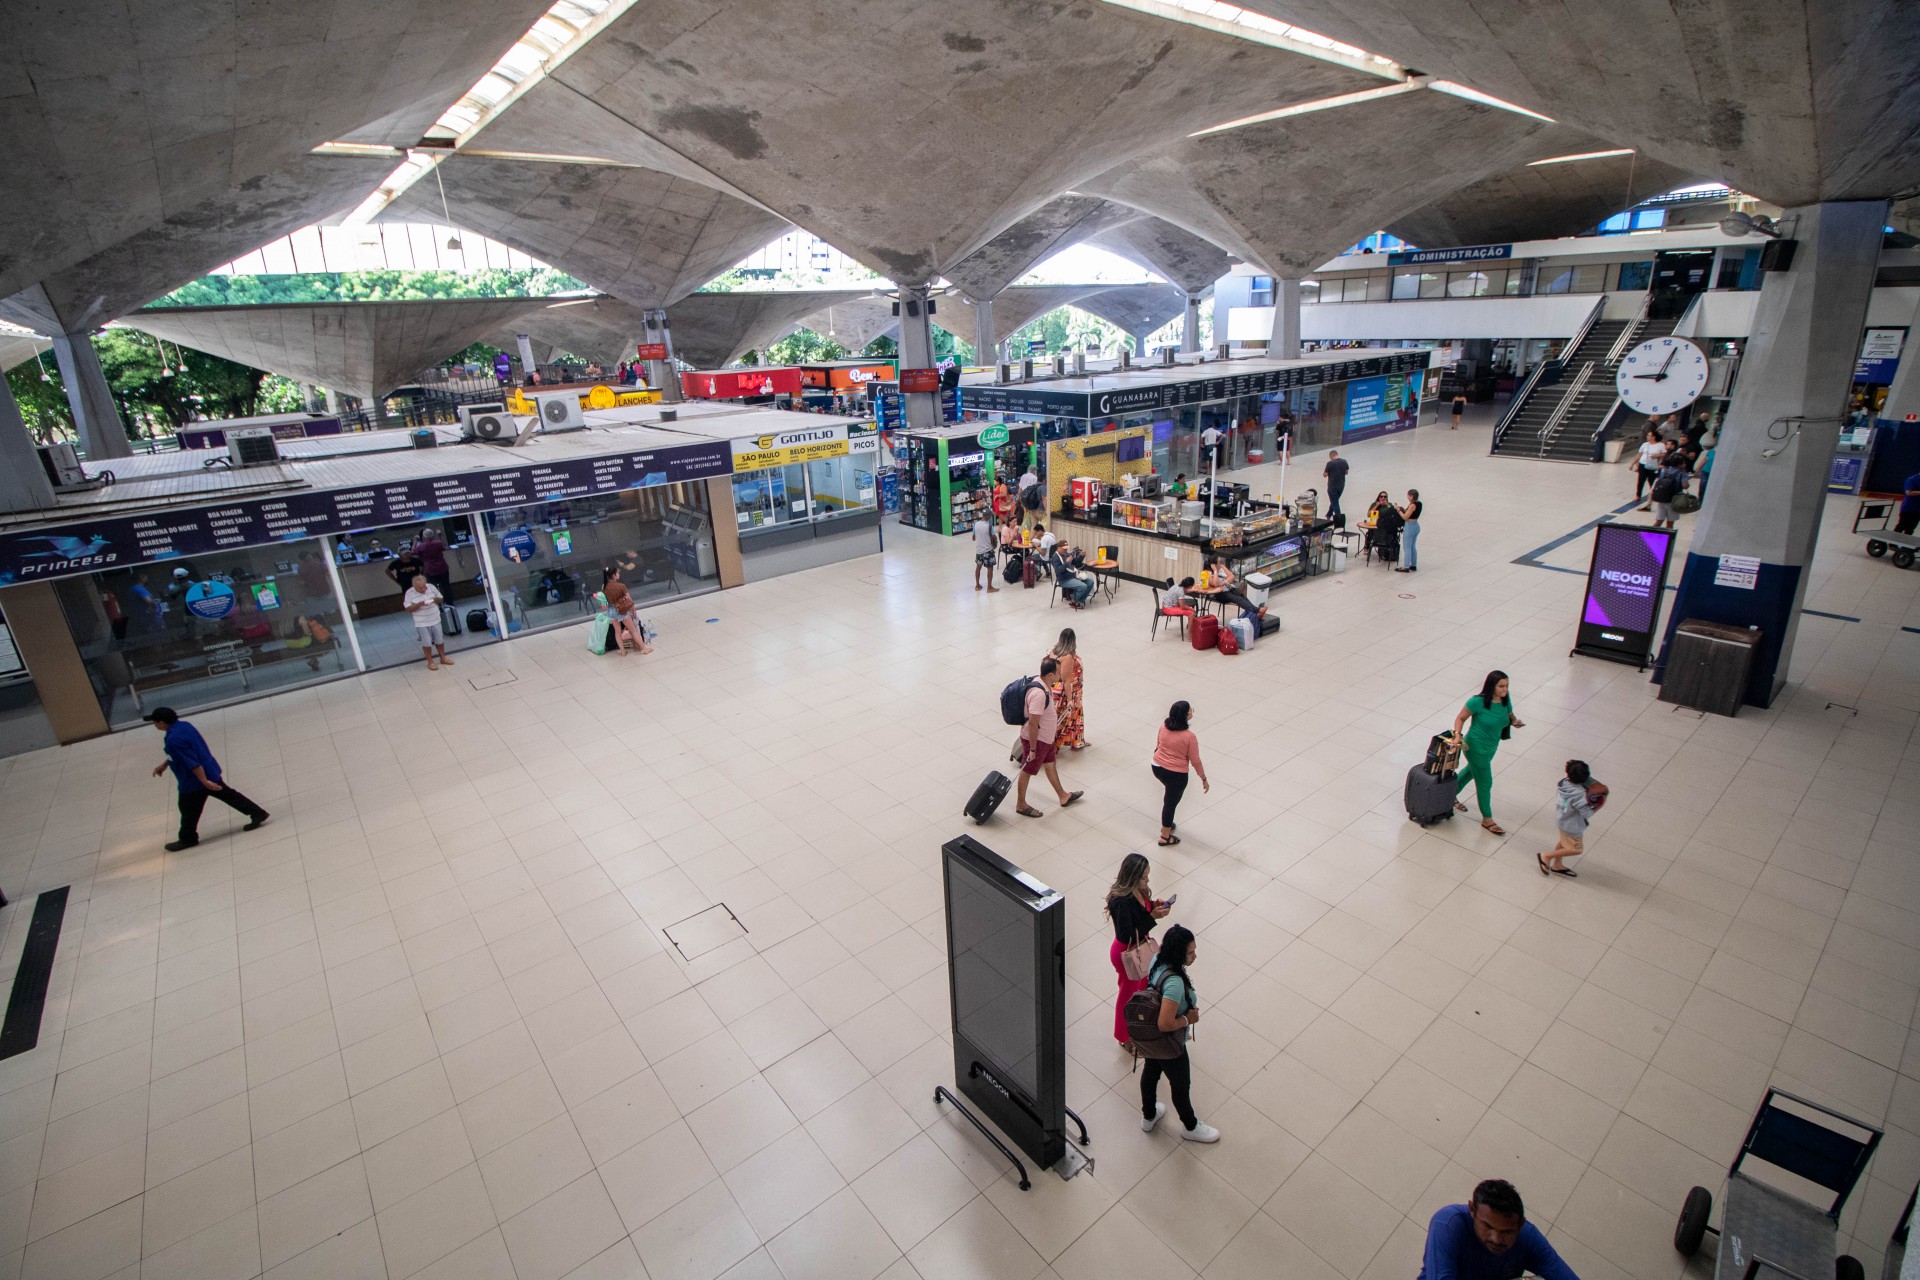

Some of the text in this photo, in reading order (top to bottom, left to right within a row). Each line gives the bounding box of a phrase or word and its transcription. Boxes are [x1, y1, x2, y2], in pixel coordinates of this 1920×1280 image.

[1411, 247, 1504, 262] ADMINISTRAÇÃO
[618, 396, 652, 406] LANCHES
[1113, 392, 1158, 404] GUANABARA
[781, 430, 833, 445] GONTIJO
[790, 448, 806, 456] BELO
[807, 443, 842, 453] HORIZONTE
[854, 440, 875, 449] PICOS
[742, 453, 756, 462] SÃO
[759, 451, 780, 460] PAULO
[433, 480, 459, 489] MADALENA
[334, 491, 376, 502] INDEPENDÊNCIA
[387, 495, 407, 503] ITATIRA
[466, 492, 484, 500] TABOSA
[262, 502, 288, 512] CATUNDA
[389, 502, 406, 511] LAGOA
[221, 508, 244, 517] VIAGEM
[264, 511, 288, 520] CRATEÚS
[338, 508, 372, 518] IPAPORANGA
[133, 520, 157, 529] AIUABA
[210, 516, 252, 528] CAMPOS SALES
[266, 518, 302, 528] GUARACIABA
[310, 514, 328, 522] NORTE
[136, 523, 198, 539] ANTONINA DO NORTE
[213, 526, 240, 537] CANINDÉ
[269, 526, 307, 538] HIDROLÂNDIA
[139, 536, 173, 547] ARARENDÁ
[216, 535, 246, 545] CARIDADE
[142, 546, 173, 557] ARNEIROZ
[1601, 570, 1652, 586] NEOOH
[1602, 633, 1624, 642] NEOOH
[982, 1069, 1010, 1098] NEOOH
